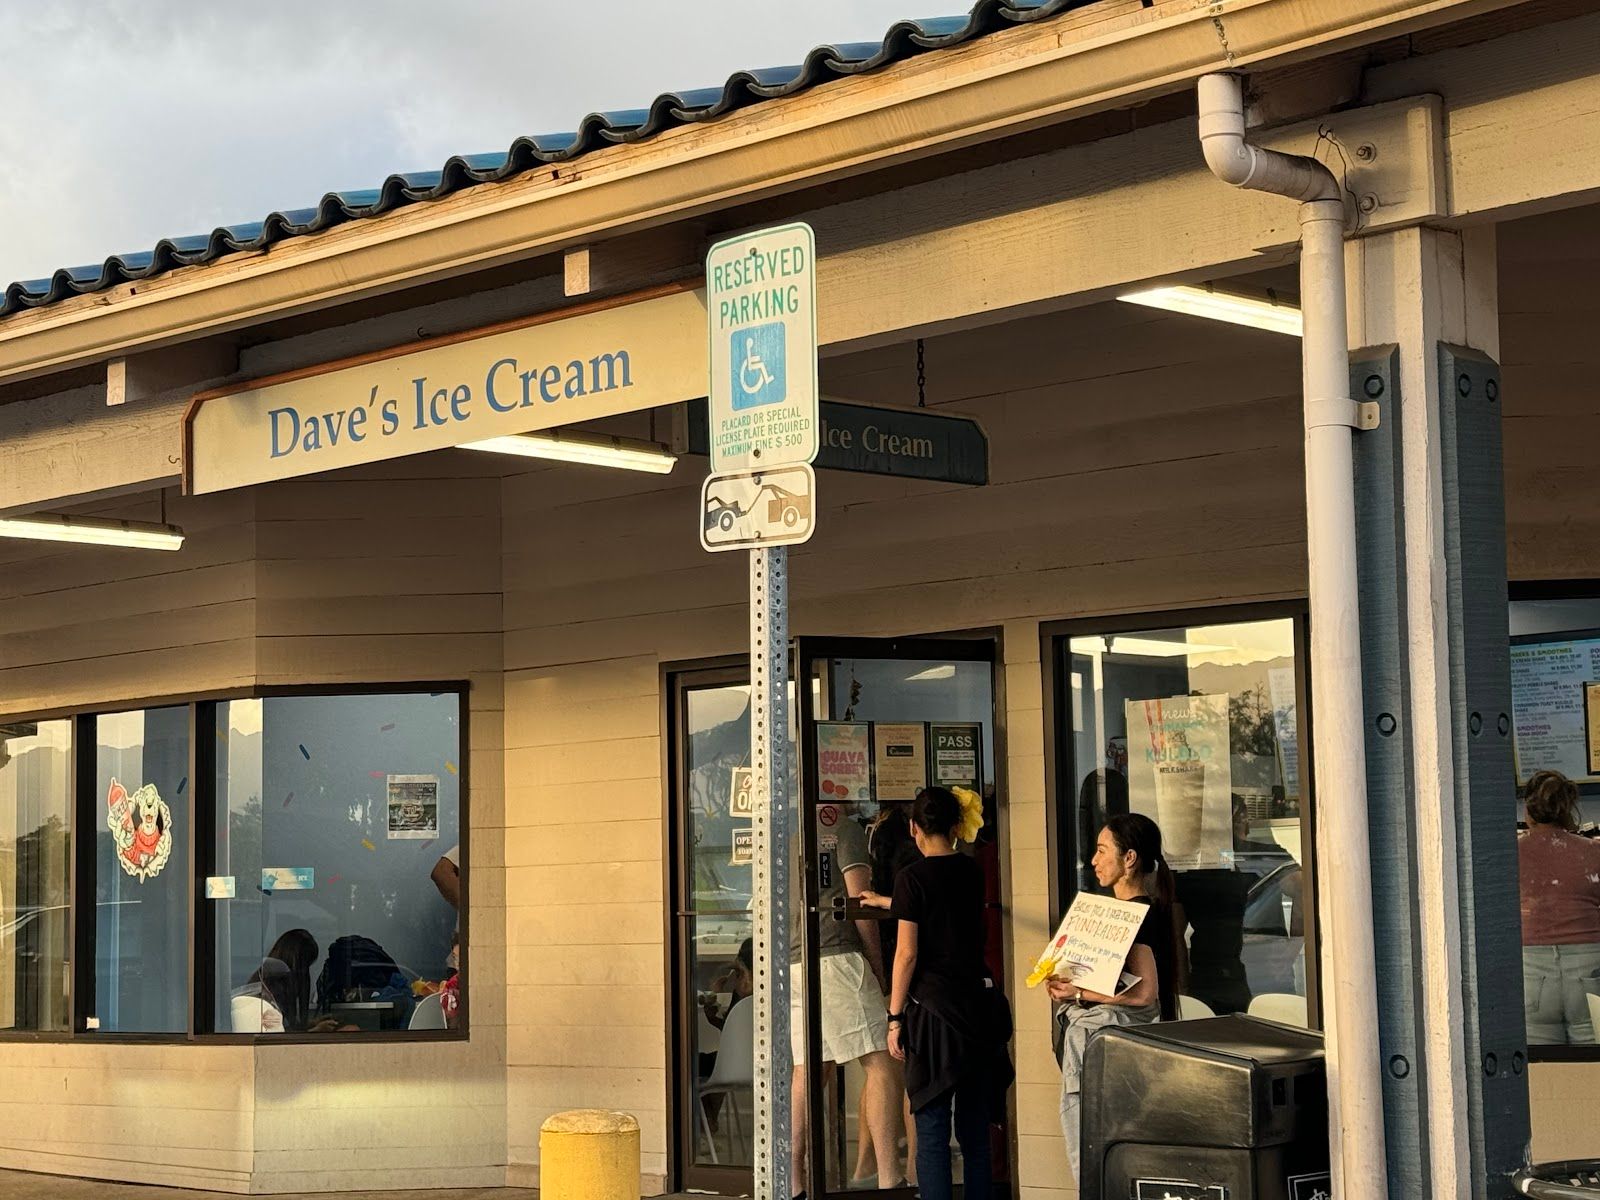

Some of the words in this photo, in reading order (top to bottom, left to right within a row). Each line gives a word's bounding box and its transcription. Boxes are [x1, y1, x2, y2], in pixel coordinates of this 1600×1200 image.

[714, 246, 804, 293] RESERVED
[720, 285, 798, 329] PARKING
[267, 384, 399, 459] Dave's
[412, 377, 471, 430] Ice
[485, 349, 633, 413] Cream
[722, 414, 751, 431] PLACARD
[753, 413, 764, 424] OR
[767, 407, 801, 422] SPECIAL
[716, 430, 742, 446] LICENSE
[743, 426, 765, 440] PLATE
[768, 419, 809, 435] REQUIRED
[722, 442, 752, 457] MAXIMUM
[755, 437, 773, 450] FINE
[785, 433, 802, 447] 500
[822, 419, 852, 449] Ice
[862, 425, 933, 459] Cream
[938, 735, 973, 748] PASS
[822, 751, 865, 764] GUAVA
[736, 836, 753, 845] OPE
